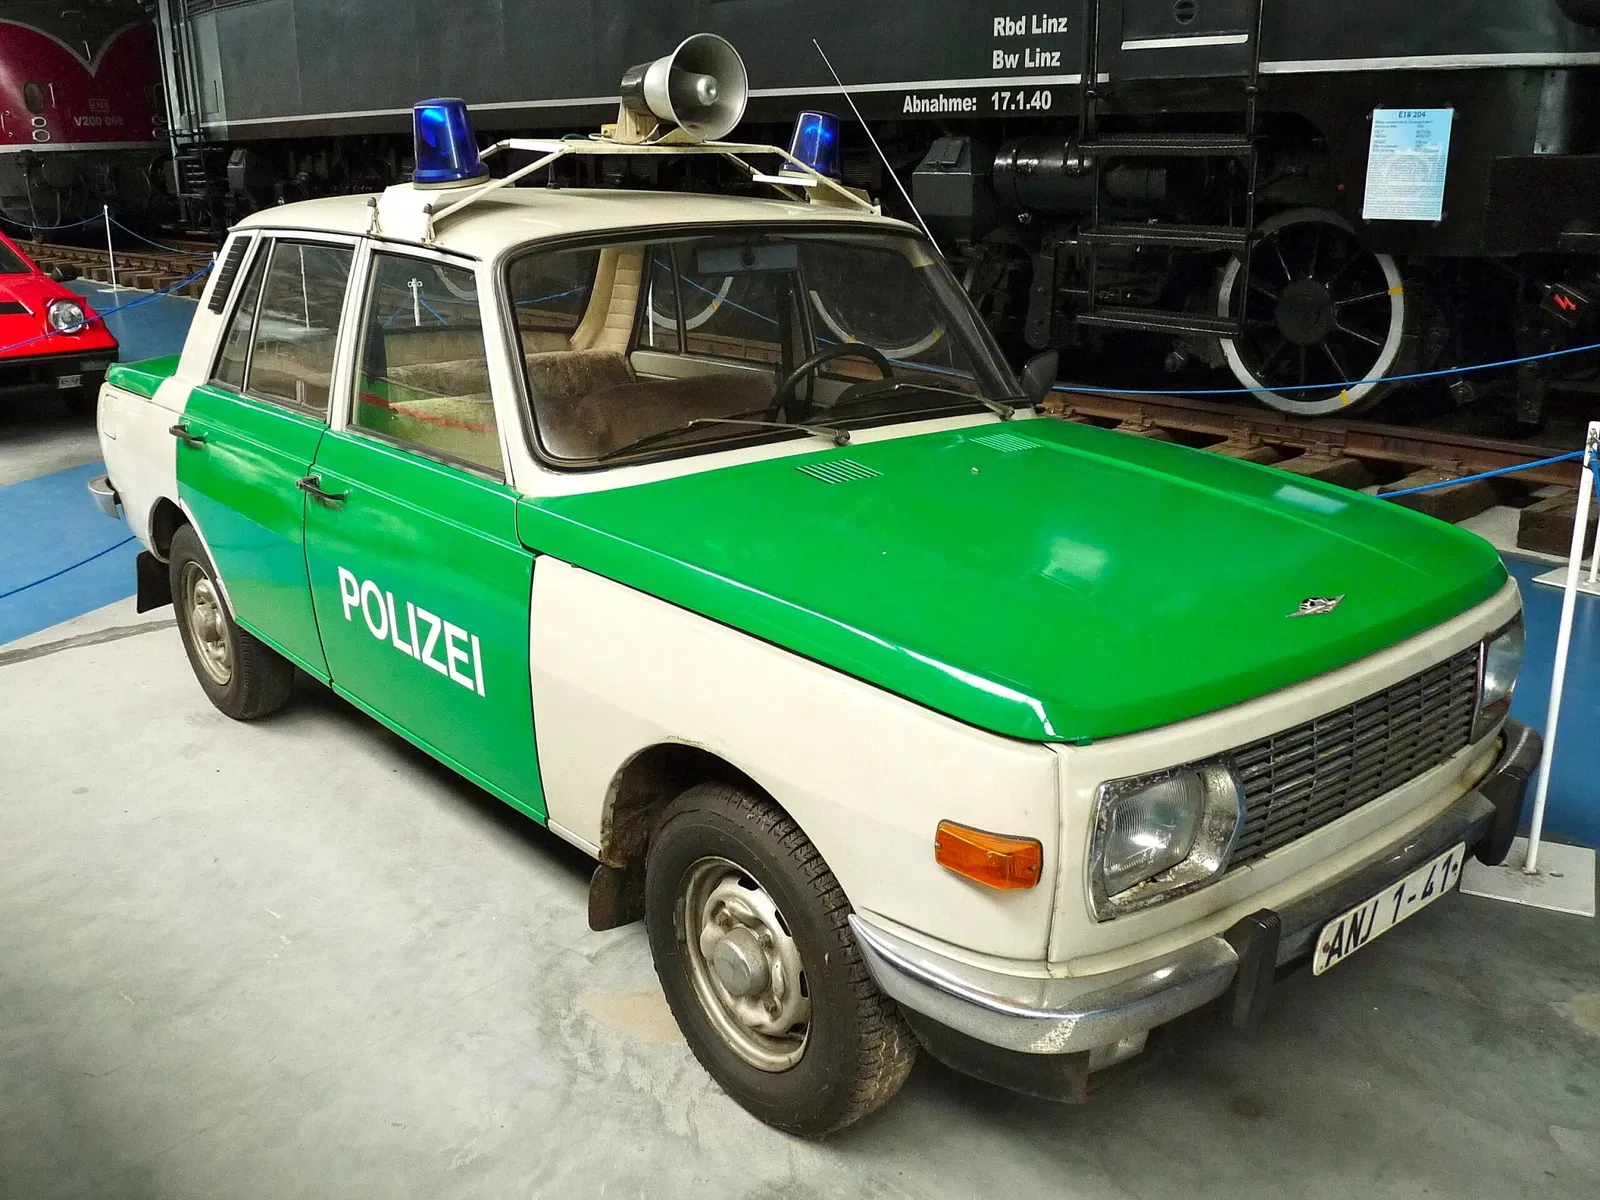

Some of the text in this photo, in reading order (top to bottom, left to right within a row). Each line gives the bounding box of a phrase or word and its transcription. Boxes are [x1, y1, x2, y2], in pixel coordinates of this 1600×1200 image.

[993, 14, 1068, 36] Rbd Linz
[992, 48, 1061, 69] Bw Linz
[903, 91, 1052, 113] Abnahme: 17.1.40
[337, 565, 486, 698] POLIZEI
[1324, 900, 1379, 968] ANJ
